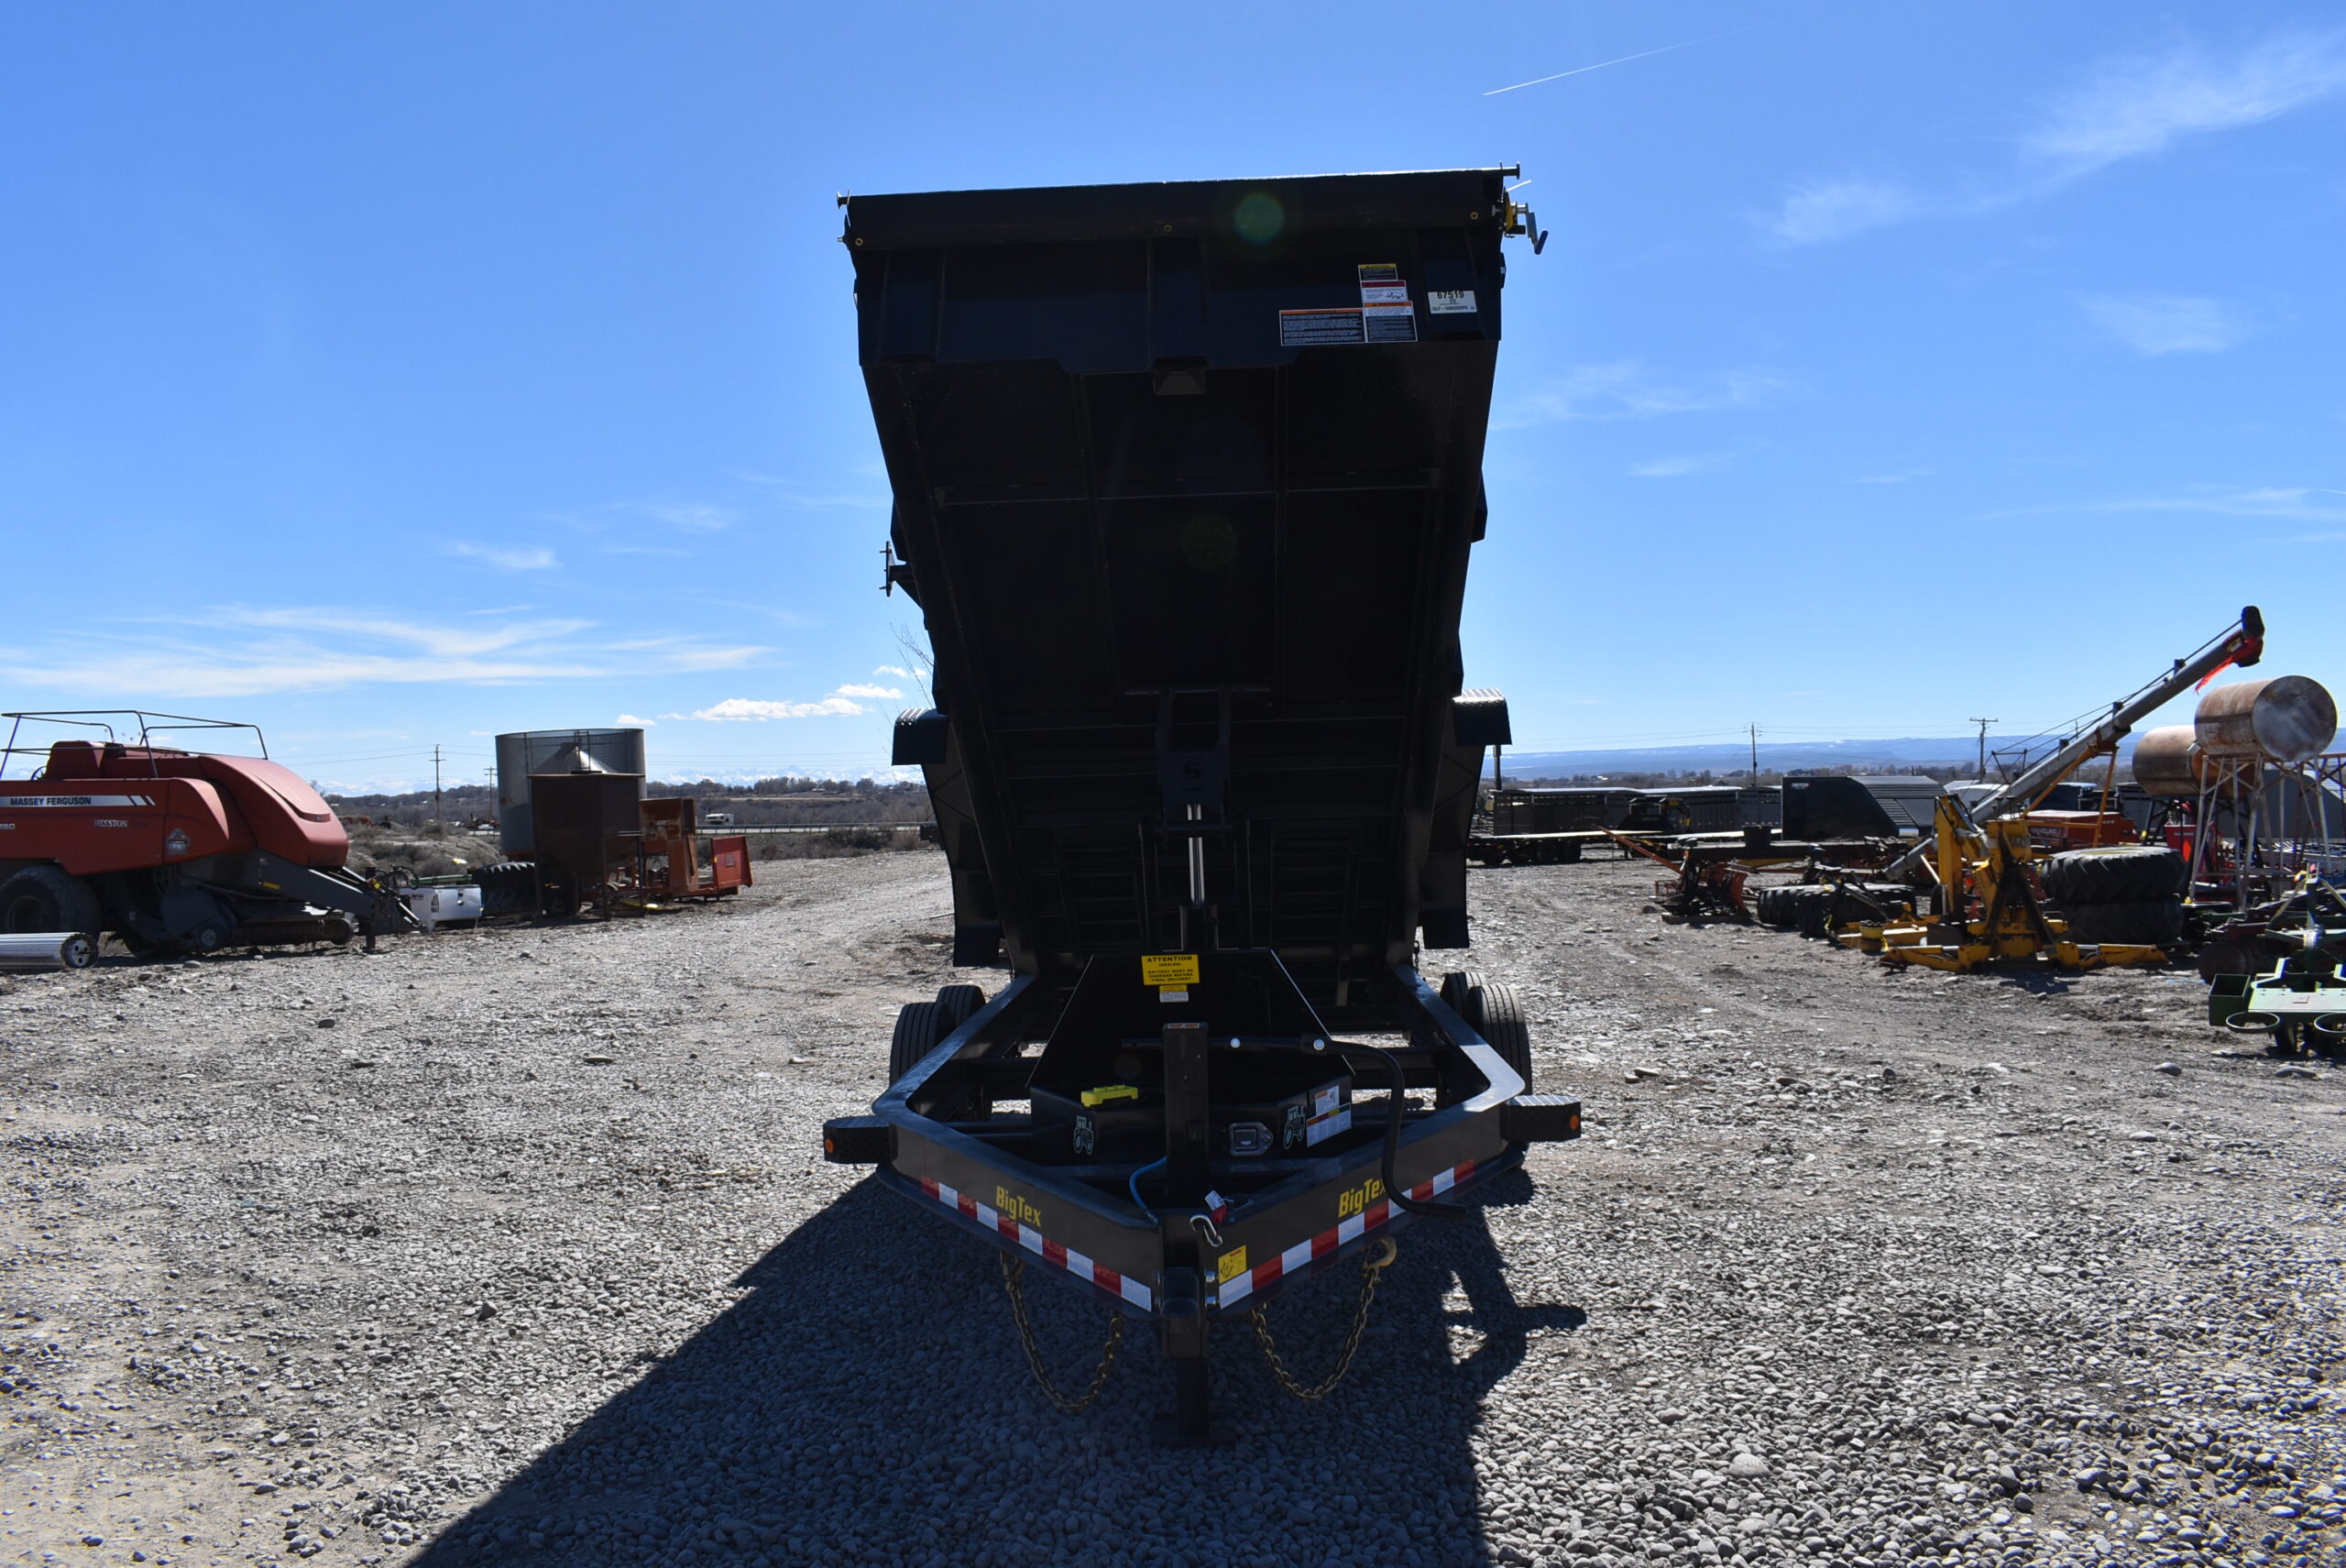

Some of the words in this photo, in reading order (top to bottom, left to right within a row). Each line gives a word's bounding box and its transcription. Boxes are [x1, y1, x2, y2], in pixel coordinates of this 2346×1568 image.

[1437, 291, 1464, 299] 67519
[10, 797, 44, 806] MASSEY
[47, 797, 92, 806] FERGUSON
[996, 1184, 1042, 1227] BigTex
